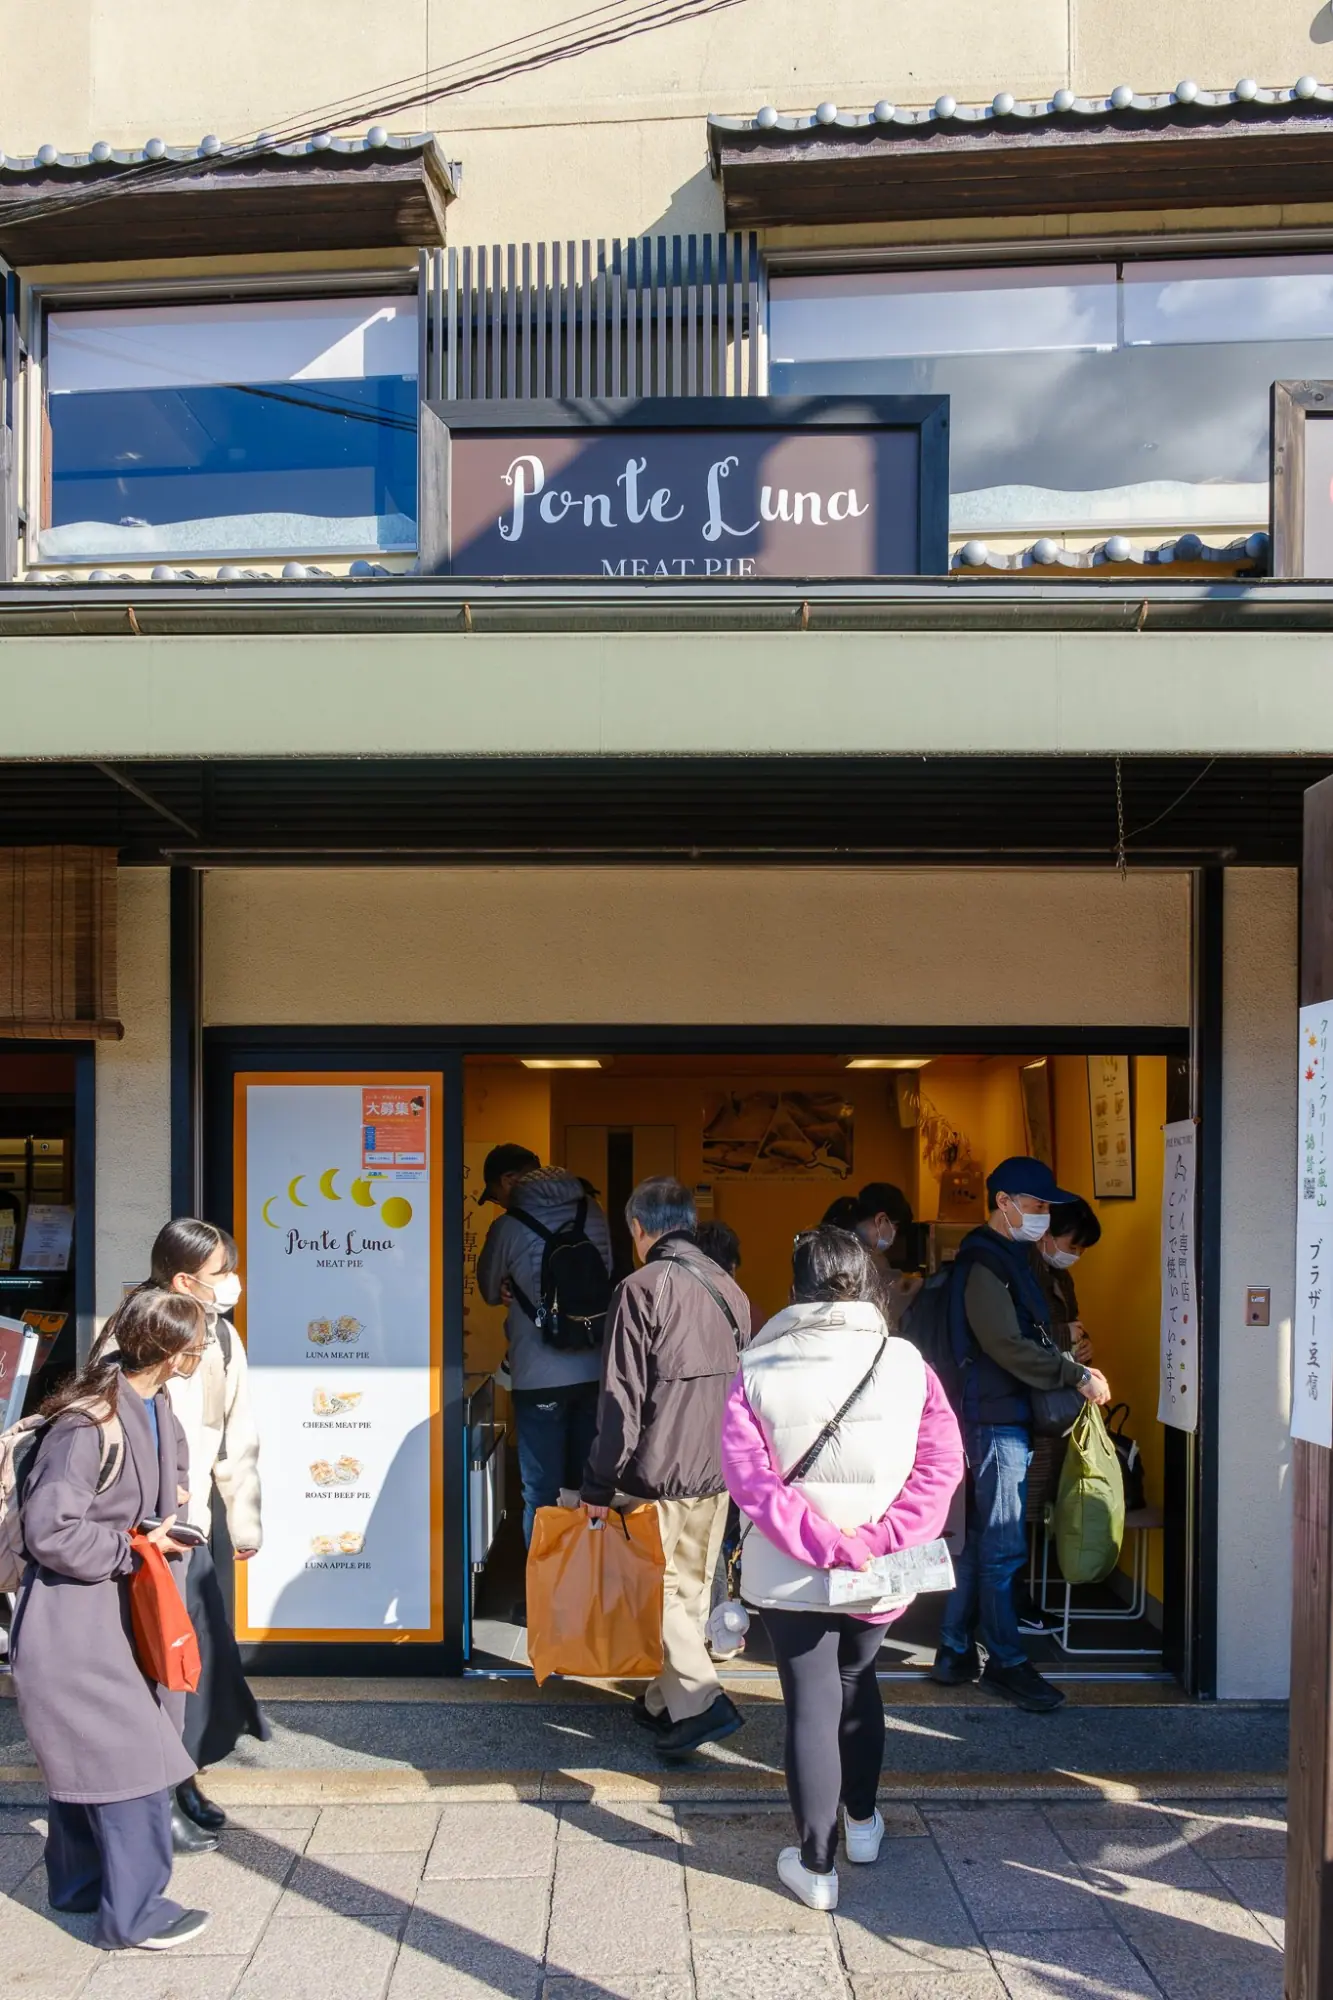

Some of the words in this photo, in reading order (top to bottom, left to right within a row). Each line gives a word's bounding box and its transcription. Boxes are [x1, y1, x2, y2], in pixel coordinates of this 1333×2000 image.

[498, 455, 684, 542] Ponte
[702, 455, 869, 542] Luna
[601, 558, 695, 576] MEAT
[704, 558, 757, 576] PIE
[366, 1101, 409, 1116] 大募集
[285, 1228, 340, 1255] Ponte
[345, 1229, 395, 1255] Luna
[1178, 1188, 1190, 1302] パイ専門店
[316, 1259, 345, 1268] MEAT
[347, 1259, 363, 1268] PIE
[305, 1351, 329, 1359] LUNA
[330, 1351, 354, 1359] MEAT
[355, 1351, 370, 1359] PIE
[302, 1421, 334, 1429] CHEESE
[335, 1421, 357, 1429] MEAT
[357, 1421, 371, 1429] PIE
[305, 1491, 332, 1499] ROAST
[334, 1491, 355, 1499] BEEF
[356, 1491, 371, 1499] PIE
[305, 1561, 328, 1570] LUNA
[329, 1561, 356, 1570] APPLE
[357, 1561, 371, 1570] PIE
